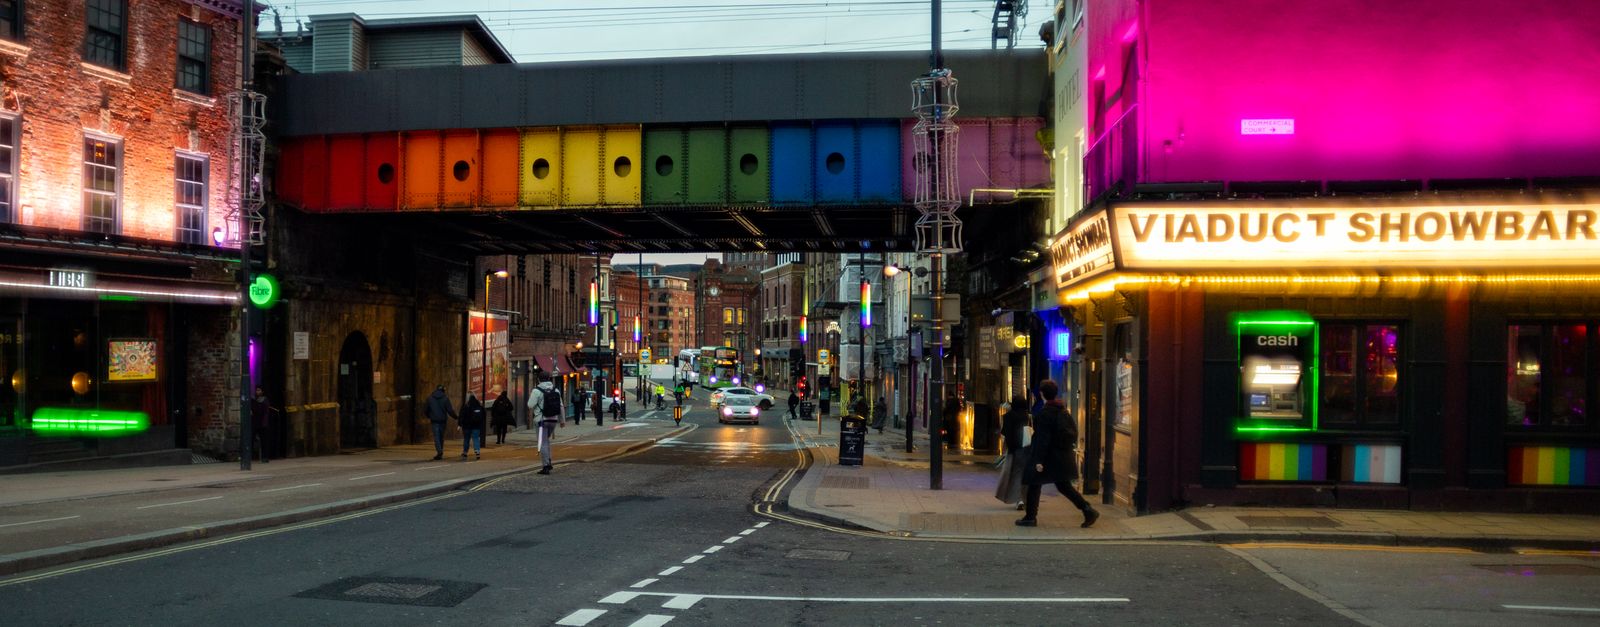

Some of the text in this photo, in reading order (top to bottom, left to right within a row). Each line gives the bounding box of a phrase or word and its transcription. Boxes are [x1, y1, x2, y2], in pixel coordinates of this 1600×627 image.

[1058, 68, 1081, 122] HOTEL
[1074, 217, 1109, 258] SHOWBAR
[1128, 209, 1598, 242] VIADUCT SHOWBAR
[1257, 332, 1298, 346] cash
